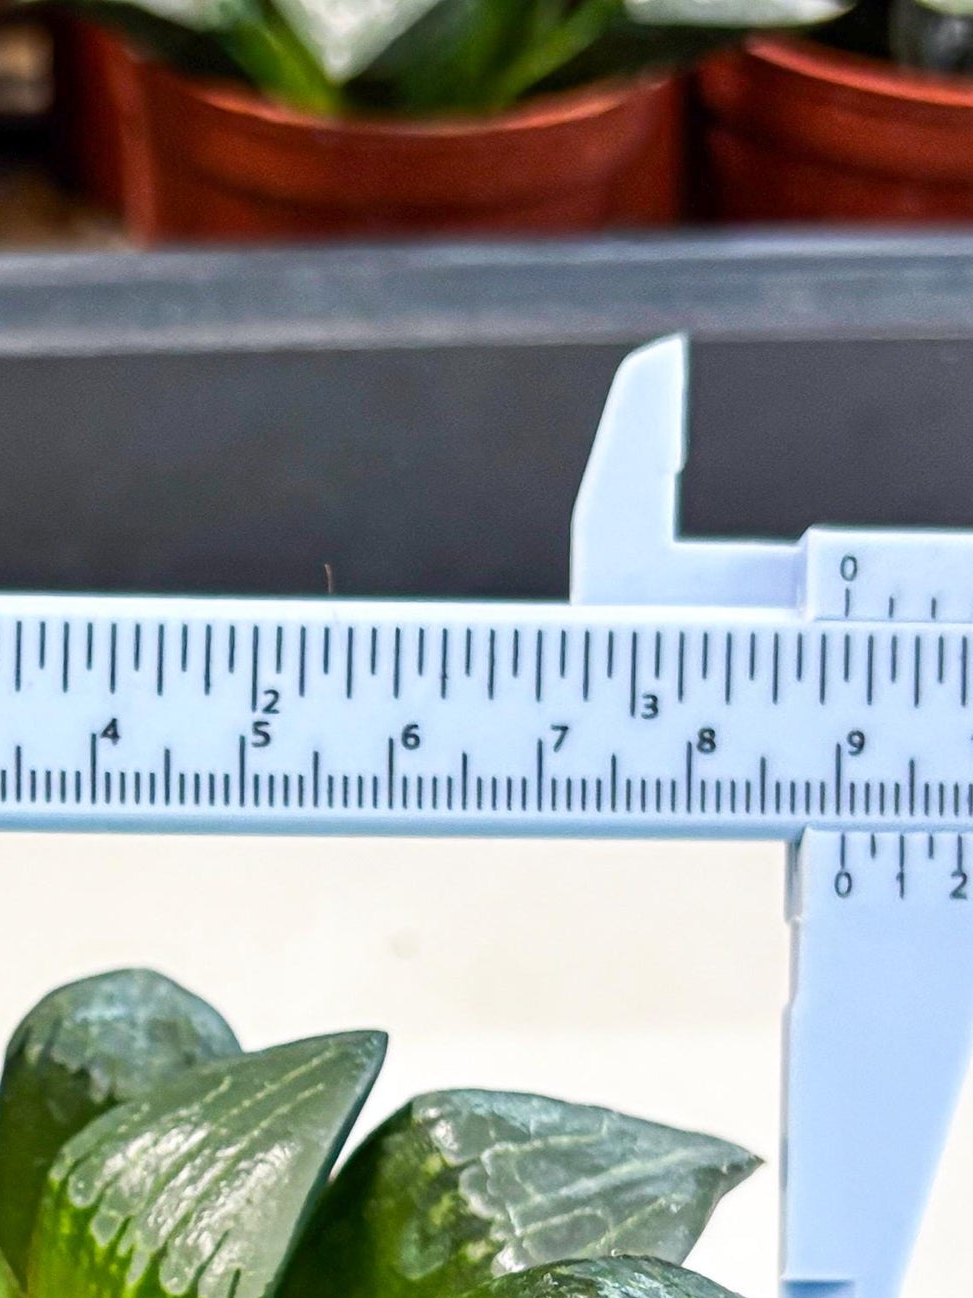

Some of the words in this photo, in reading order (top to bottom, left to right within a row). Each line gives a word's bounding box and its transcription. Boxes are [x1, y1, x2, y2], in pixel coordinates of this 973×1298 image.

[839, 553, 858, 582] 0
[261, 689, 282, 715] 2
[640, 694, 659, 720] 3
[100, 717, 121, 745] 4
[251, 721, 272, 748] 5
[400, 723, 422, 750] 6
[549, 724, 570, 752] 7
[696, 727, 718, 754] 8
[846, 729, 866, 756] 9
[834, 871, 853, 899] 0
[895, 872, 907, 900] 1
[949, 871, 969, 900] 2
